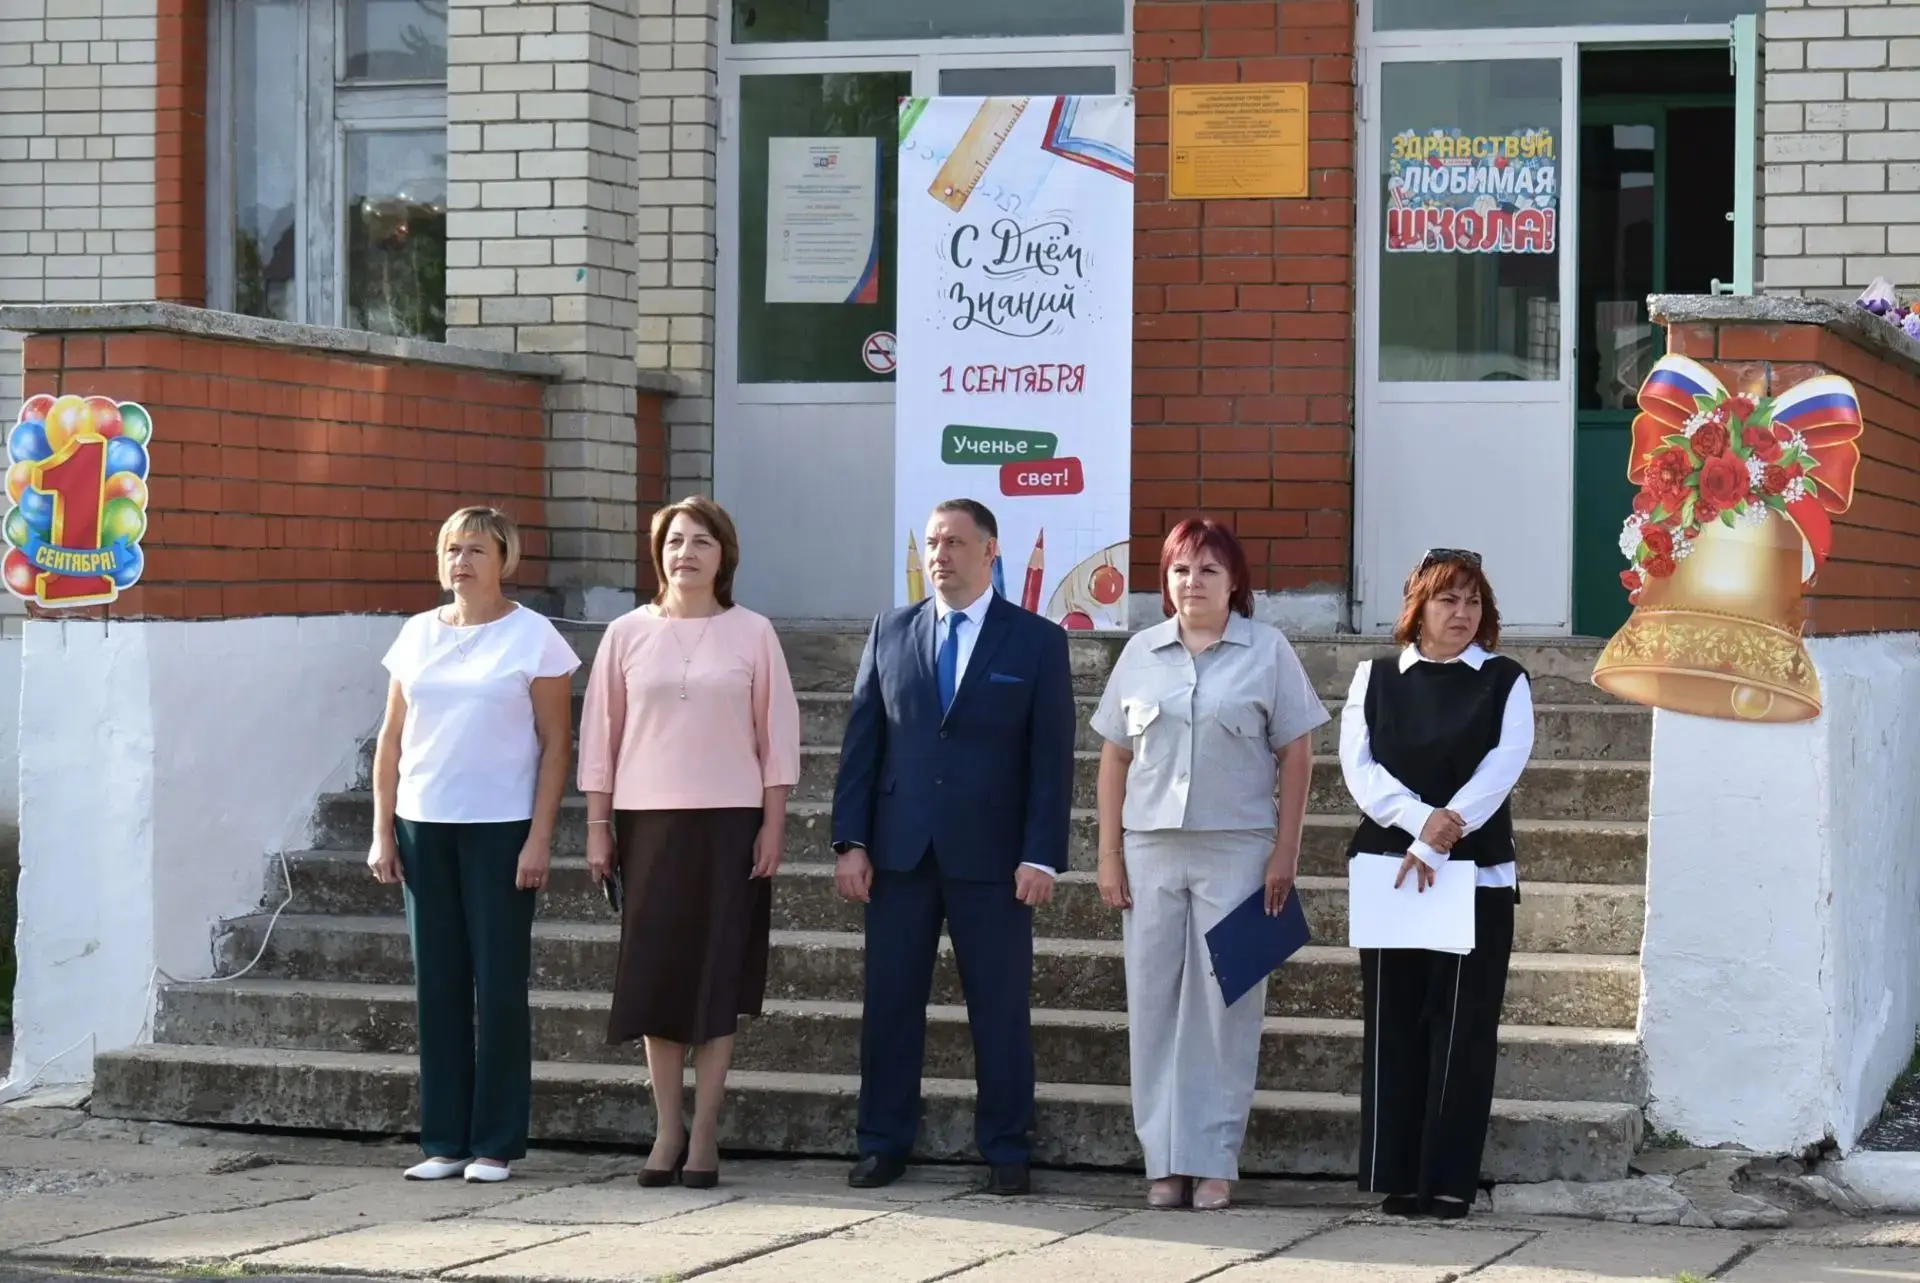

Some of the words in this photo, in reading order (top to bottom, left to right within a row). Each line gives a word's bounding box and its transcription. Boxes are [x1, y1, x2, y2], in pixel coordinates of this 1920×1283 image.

[1390, 129, 1557, 161] ЗДРАВСТВУЙ,
[1402, 165, 1555, 194] ЛЮБИМАЯ
[1386, 207, 1556, 253] ШКОЛА!
[950, 224, 980, 269] С
[982, 218, 1083, 278] Днём
[949, 281, 1076, 338] Знаний
[939, 365, 955, 393] 1
[962, 363, 1086, 395] СЕНТЯБРЯ
[952, 435, 1029, 455] Ученье
[1016, 467, 1069, 487] свет!
[31, 433, 115, 601] 1
[35, 545, 117, 573] СЕНТЯБРЯ!
